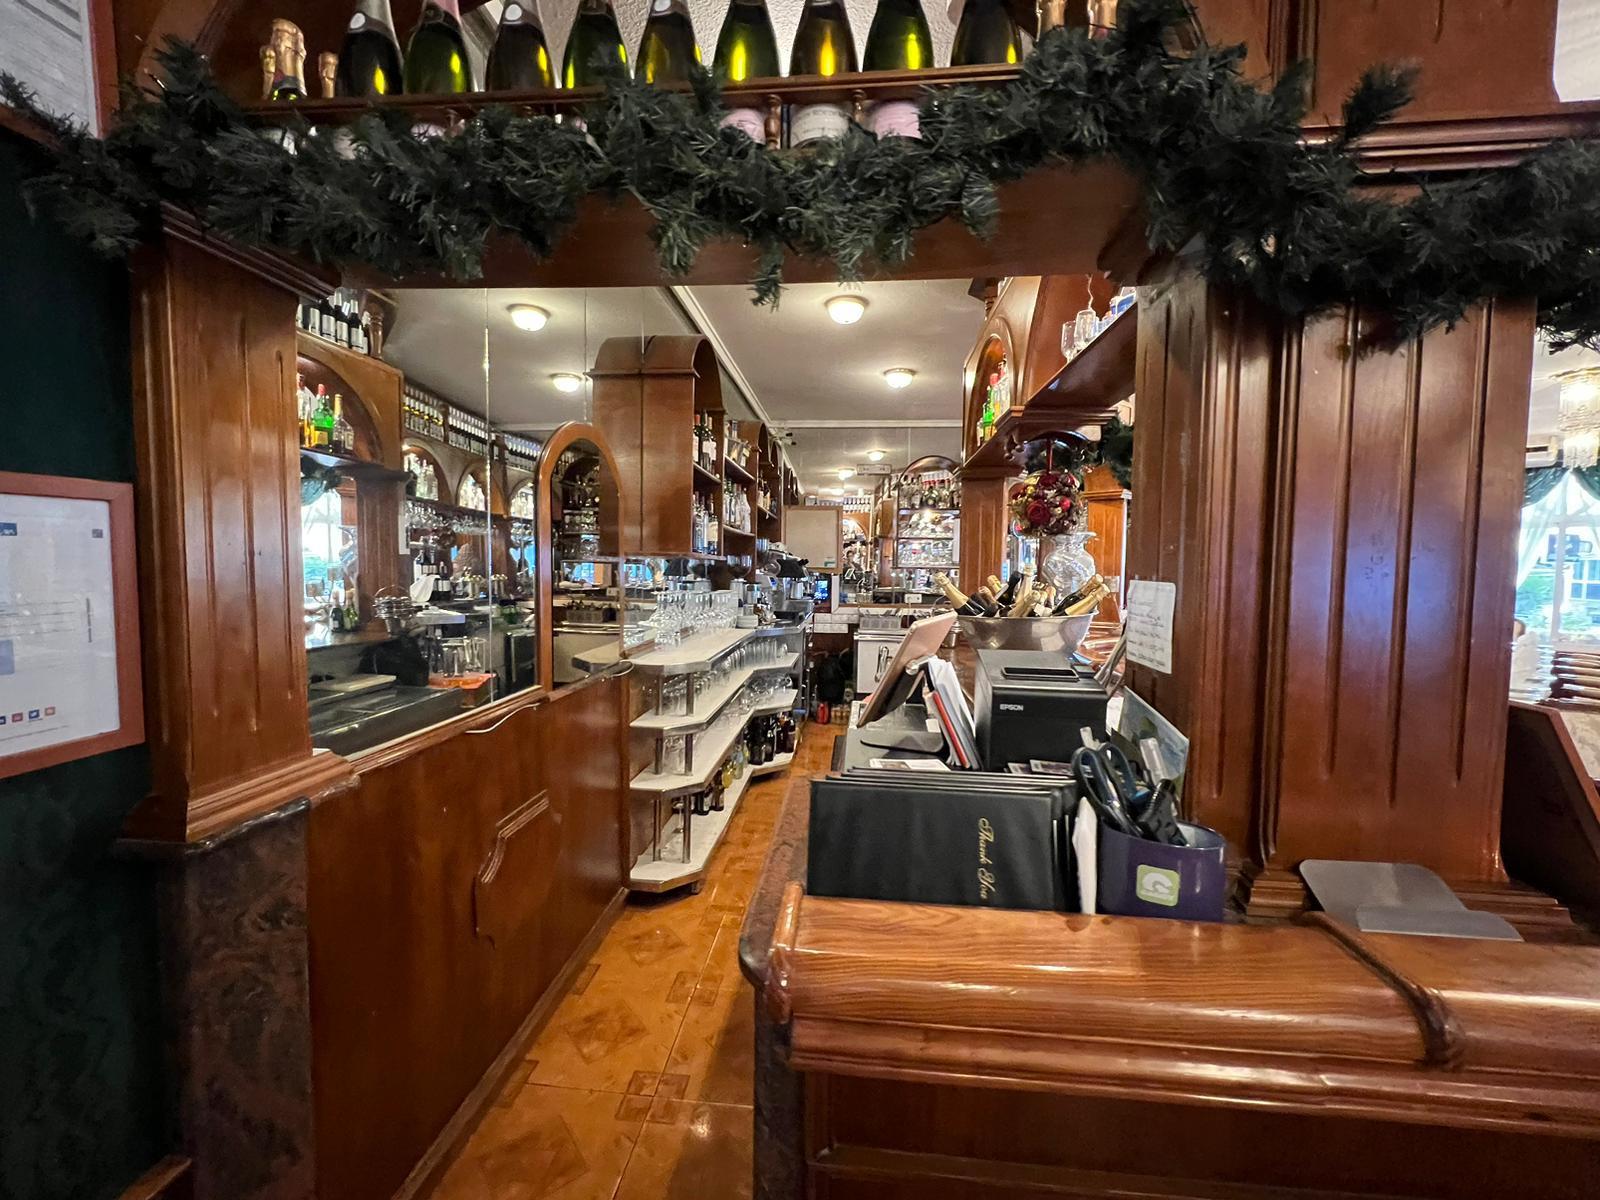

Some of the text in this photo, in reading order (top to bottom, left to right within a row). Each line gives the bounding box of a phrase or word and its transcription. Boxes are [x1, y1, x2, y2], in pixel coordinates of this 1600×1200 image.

[999, 703, 1024, 711] EPSON
[977, 817, 996, 899] Thank You
